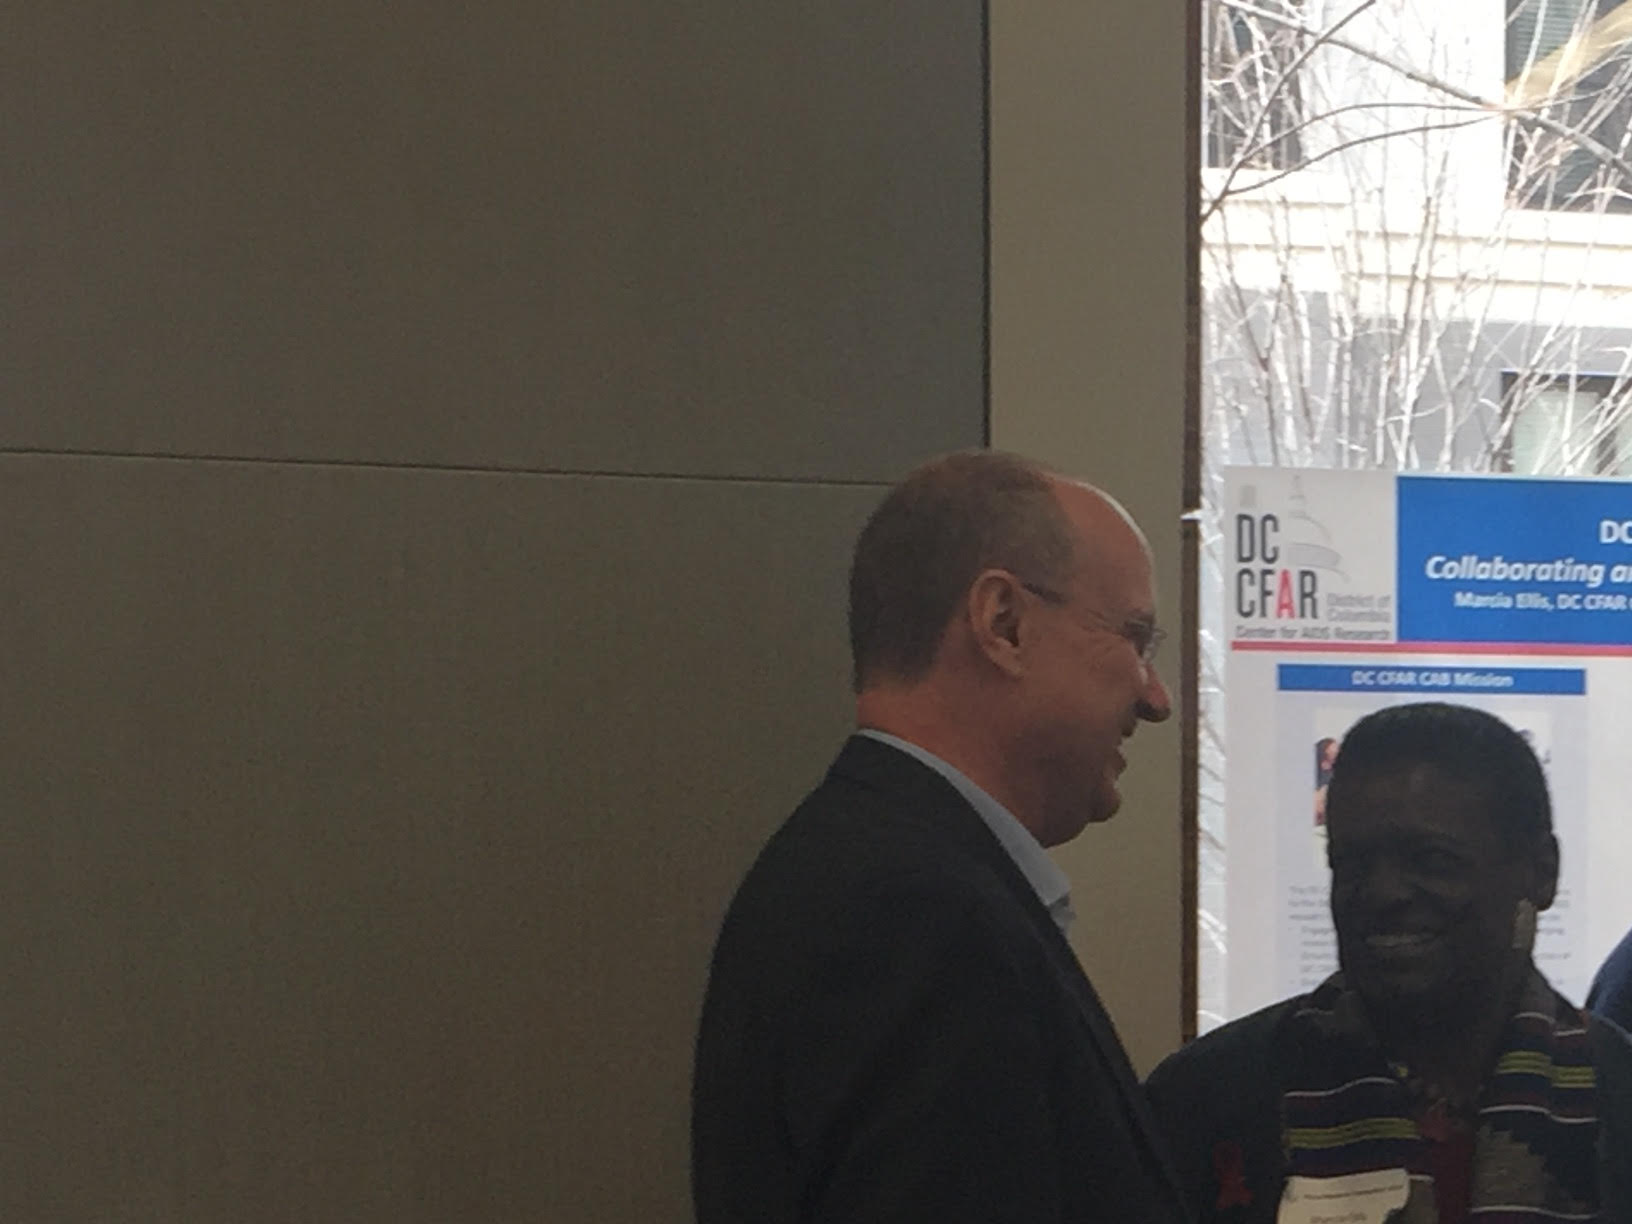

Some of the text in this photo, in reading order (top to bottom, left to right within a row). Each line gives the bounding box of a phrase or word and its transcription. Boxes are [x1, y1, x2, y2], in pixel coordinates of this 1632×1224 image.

[1236, 514, 1279, 564] DC
[1425, 555, 1605, 587] Collaborating
[1236, 568, 1318, 619] CFAR
[1454, 592, 1513, 608] Marcia
[1556, 594, 1582, 609] DC
[1584, 594, 1627, 610] CFAR
[1352, 670, 1514, 687] DC CFAR CAB Mission
